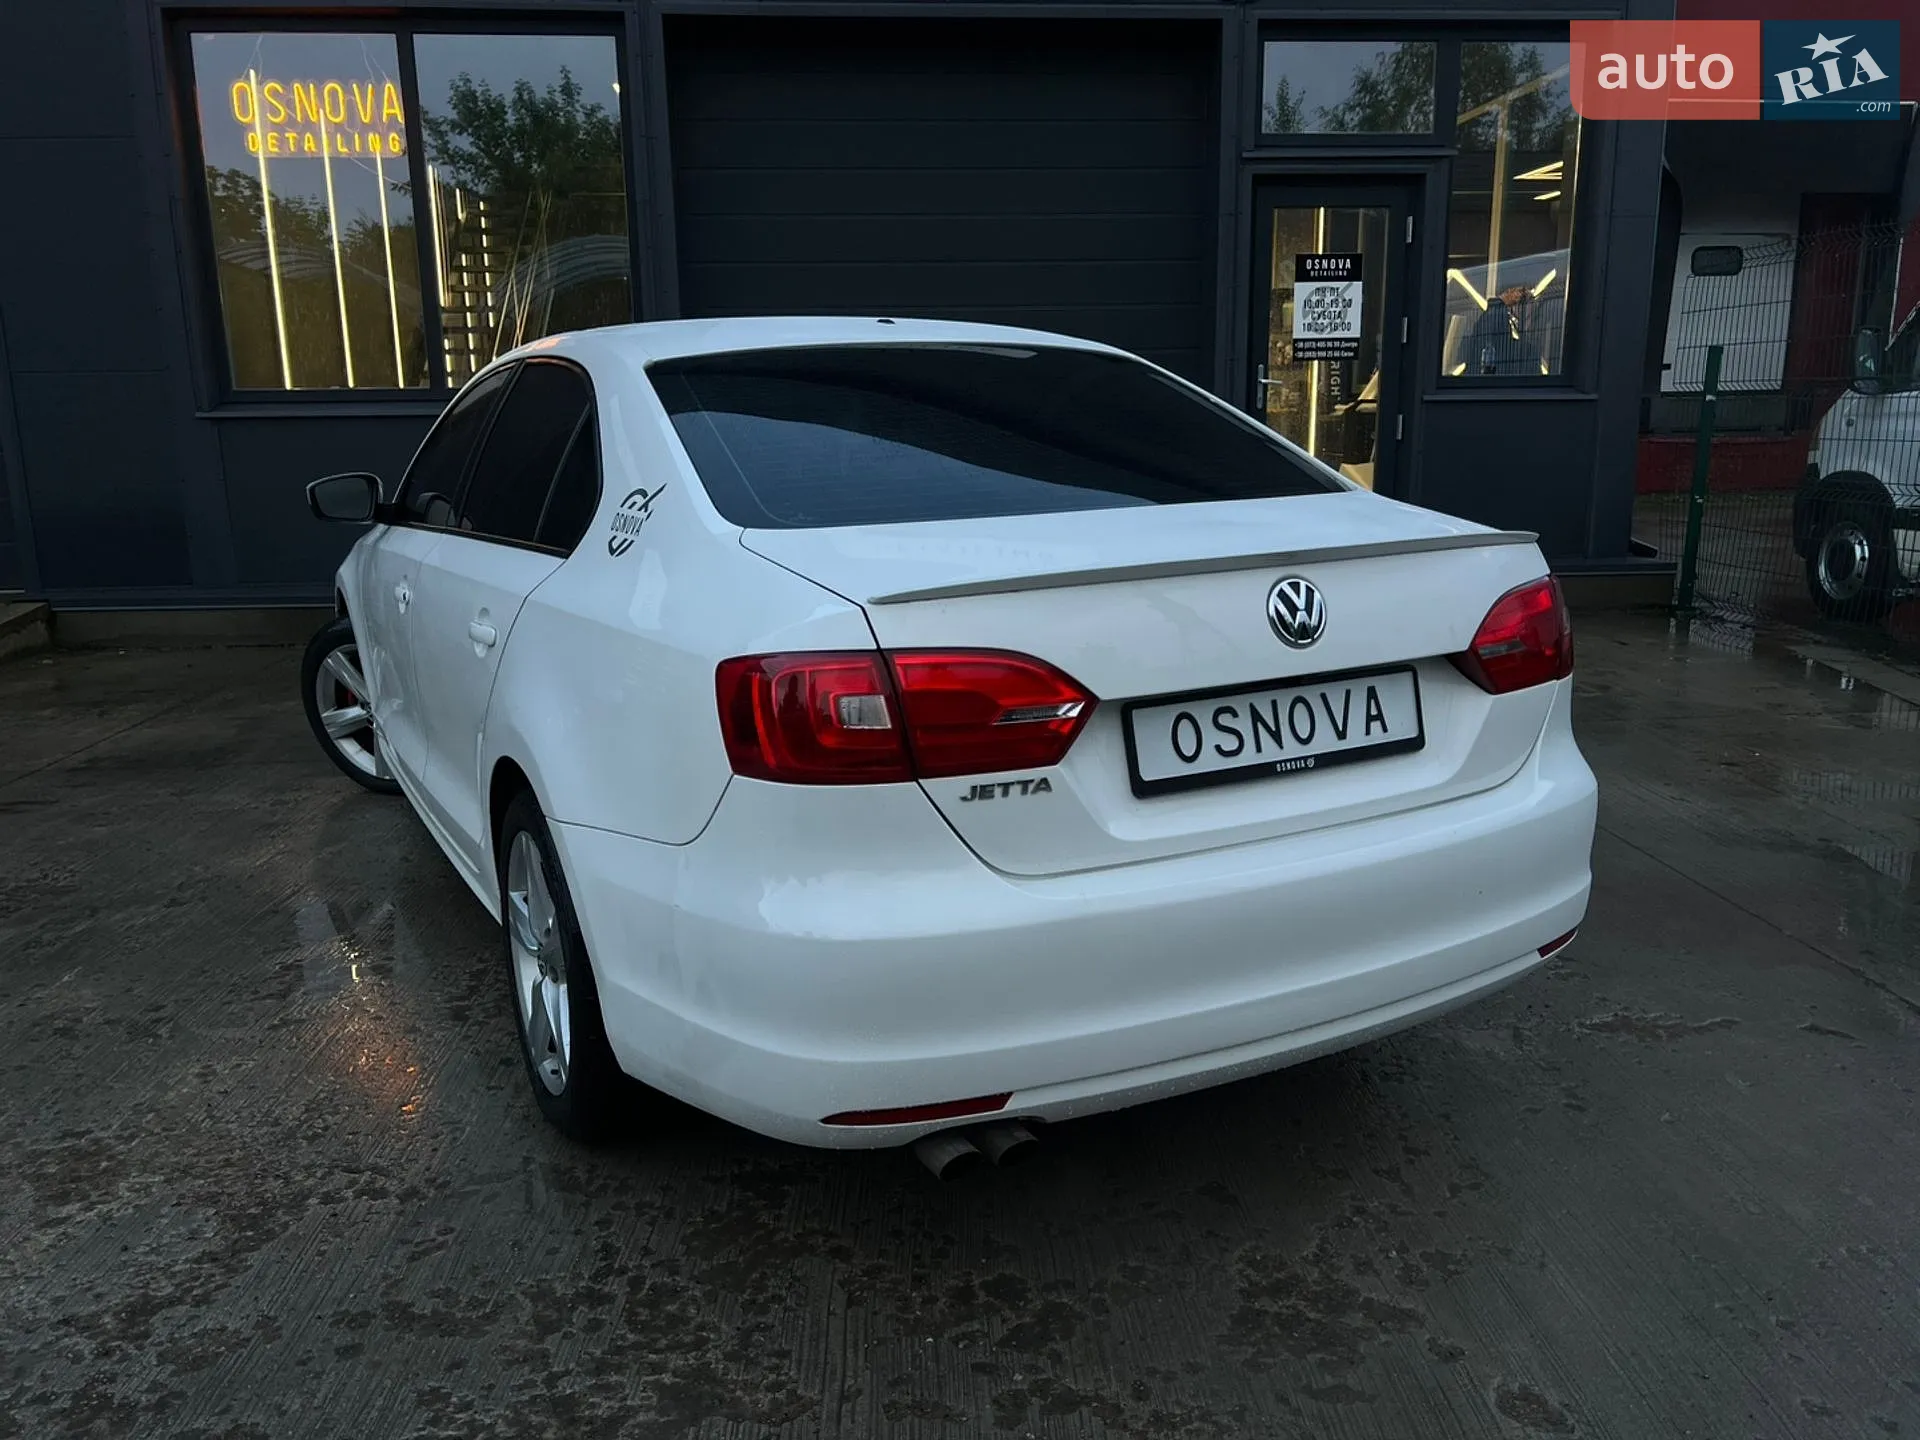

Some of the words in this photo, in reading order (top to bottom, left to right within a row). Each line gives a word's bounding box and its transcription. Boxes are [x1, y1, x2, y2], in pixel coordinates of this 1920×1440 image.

[231, 81, 404, 124] OSNOVA
[1306, 258, 1351, 270] OSNOVA
[1310, 310, 1342, 321] СУБОТА
[1171, 685, 1389, 764] OSNOVA
[1276, 759, 1305, 772] OSNOVA
[959, 777, 1053, 802] JETTA
